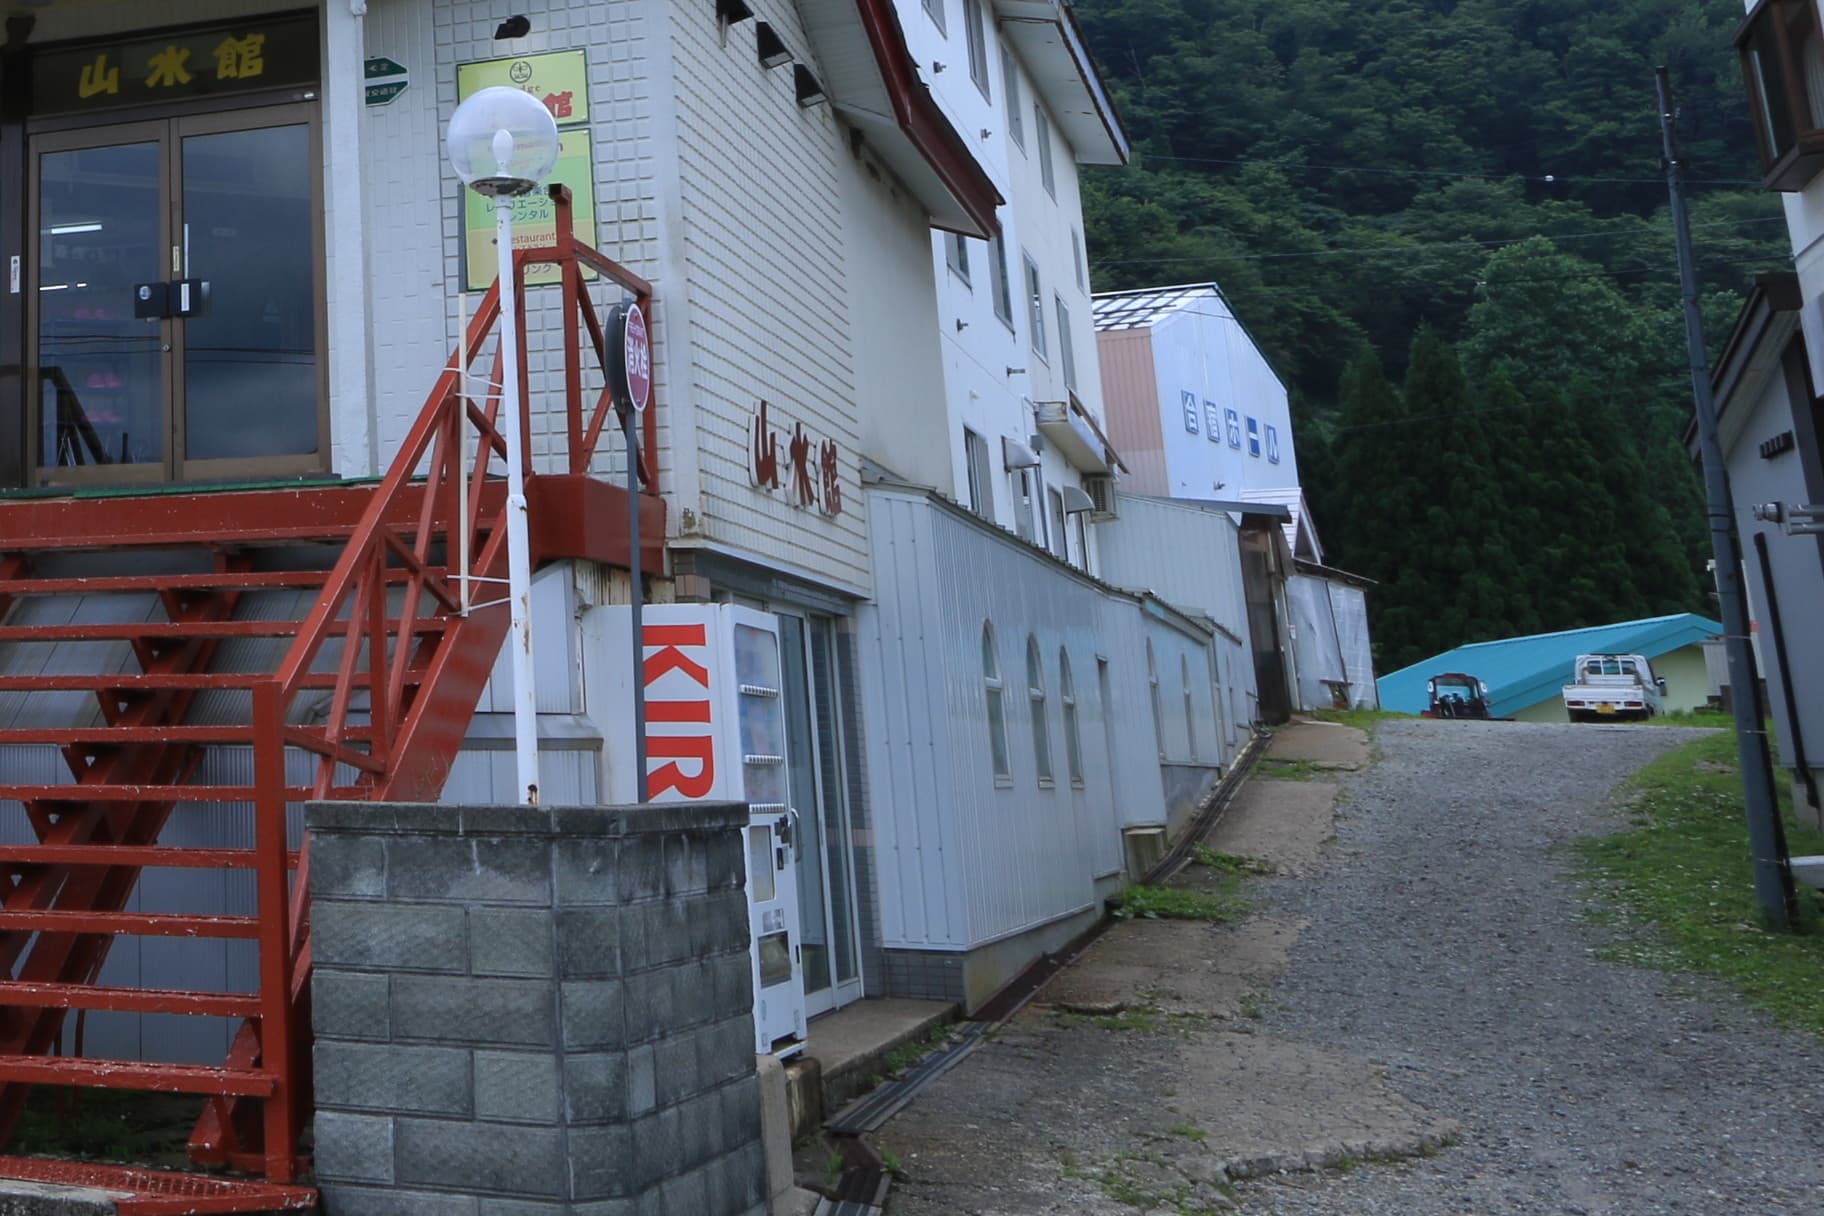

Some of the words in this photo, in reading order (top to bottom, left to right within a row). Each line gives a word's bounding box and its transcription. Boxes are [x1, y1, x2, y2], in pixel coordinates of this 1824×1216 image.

[77, 32, 266, 99] 山水館
[511, 231, 557, 244] estaurant
[751, 398, 843, 516] 山水館
[1182, 390, 1280, 465] 合宿ホール
